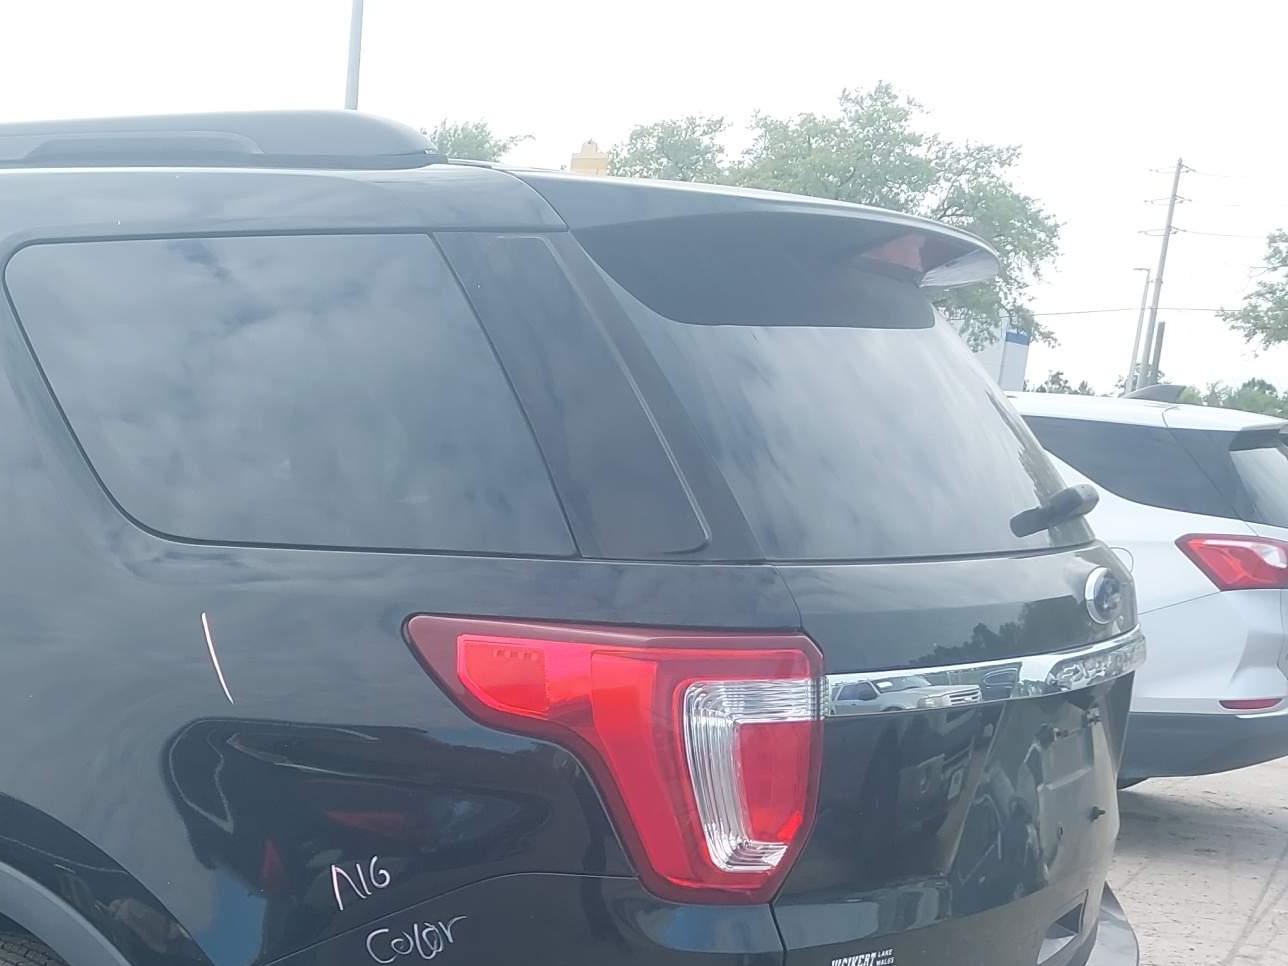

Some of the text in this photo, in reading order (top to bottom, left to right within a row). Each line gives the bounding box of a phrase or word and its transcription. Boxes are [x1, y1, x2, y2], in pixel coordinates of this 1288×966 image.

[366, 915, 468, 964] Color
[878, 949, 893, 958] LAKE
[876, 957, 894, 966] WALES
